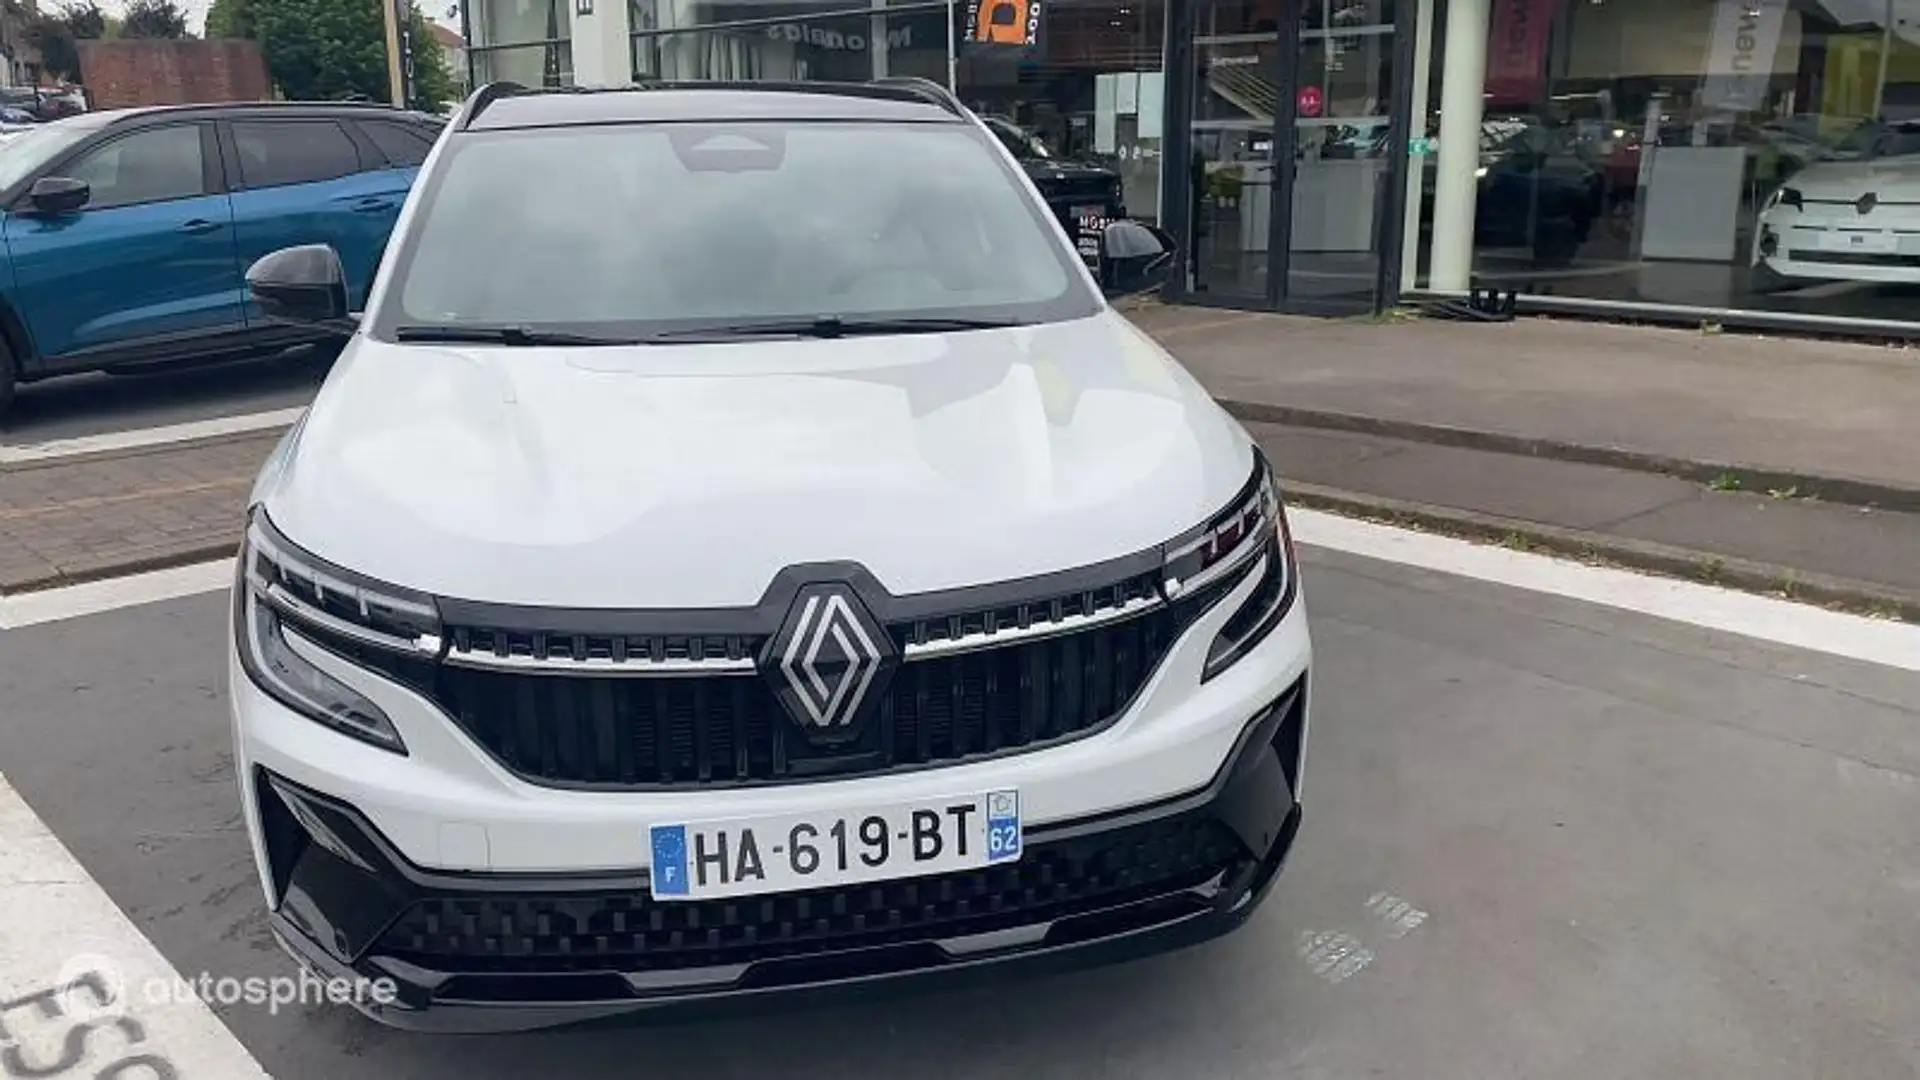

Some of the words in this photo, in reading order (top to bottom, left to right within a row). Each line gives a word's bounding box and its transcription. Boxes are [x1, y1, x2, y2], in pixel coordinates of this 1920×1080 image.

[664, 866, 677, 883] F
[695, 803, 976, 887] HA-619-BT
[990, 825, 1017, 852] 62
